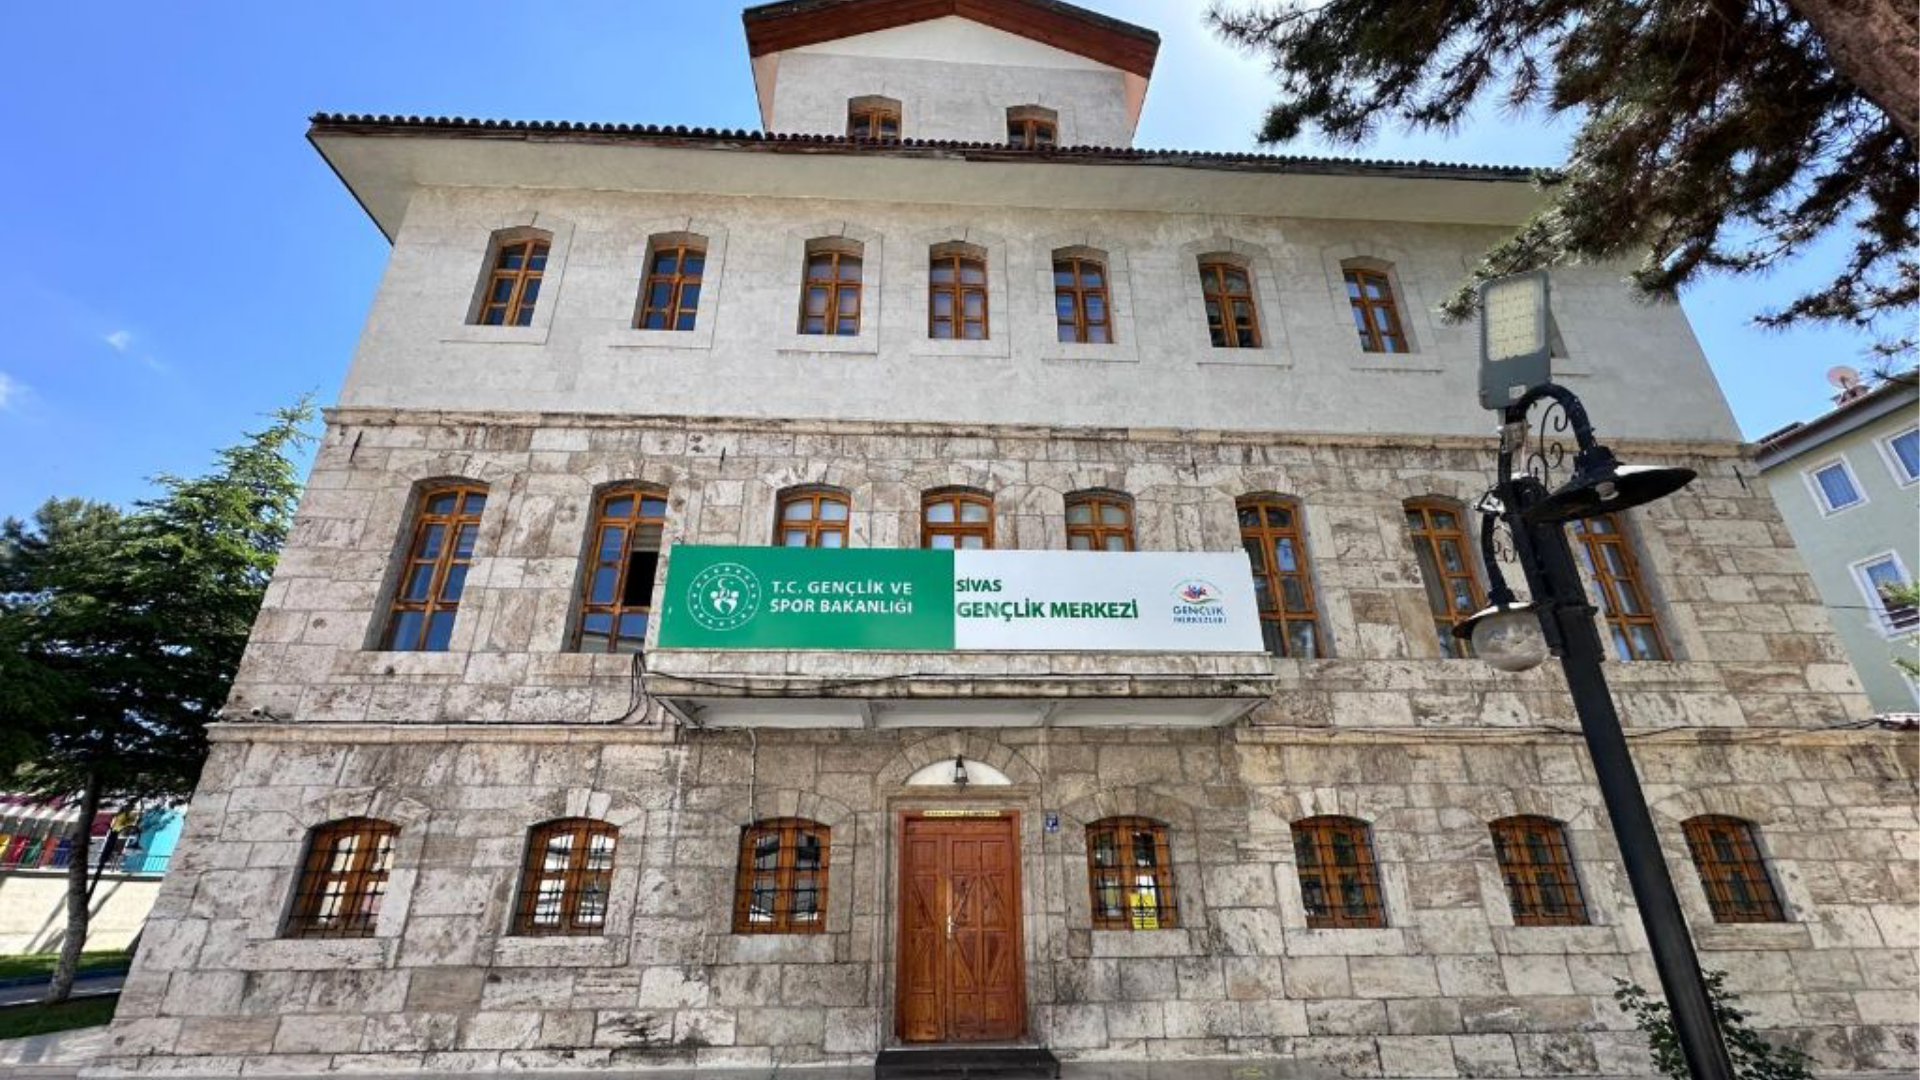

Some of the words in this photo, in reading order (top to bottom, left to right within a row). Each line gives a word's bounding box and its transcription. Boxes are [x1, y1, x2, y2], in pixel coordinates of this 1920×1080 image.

[771, 581, 802, 594] T.C.
[807, 579, 884, 597] GENÇLİK
[890, 582, 912, 595] VE
[956, 577, 1002, 592] SİVAS
[770, 598, 815, 613] SPOR
[820, 598, 912, 614] BAKANLIĞI
[956, 598, 1045, 622] GENÇLİK
[1050, 598, 1139, 618] MERKEZİ
